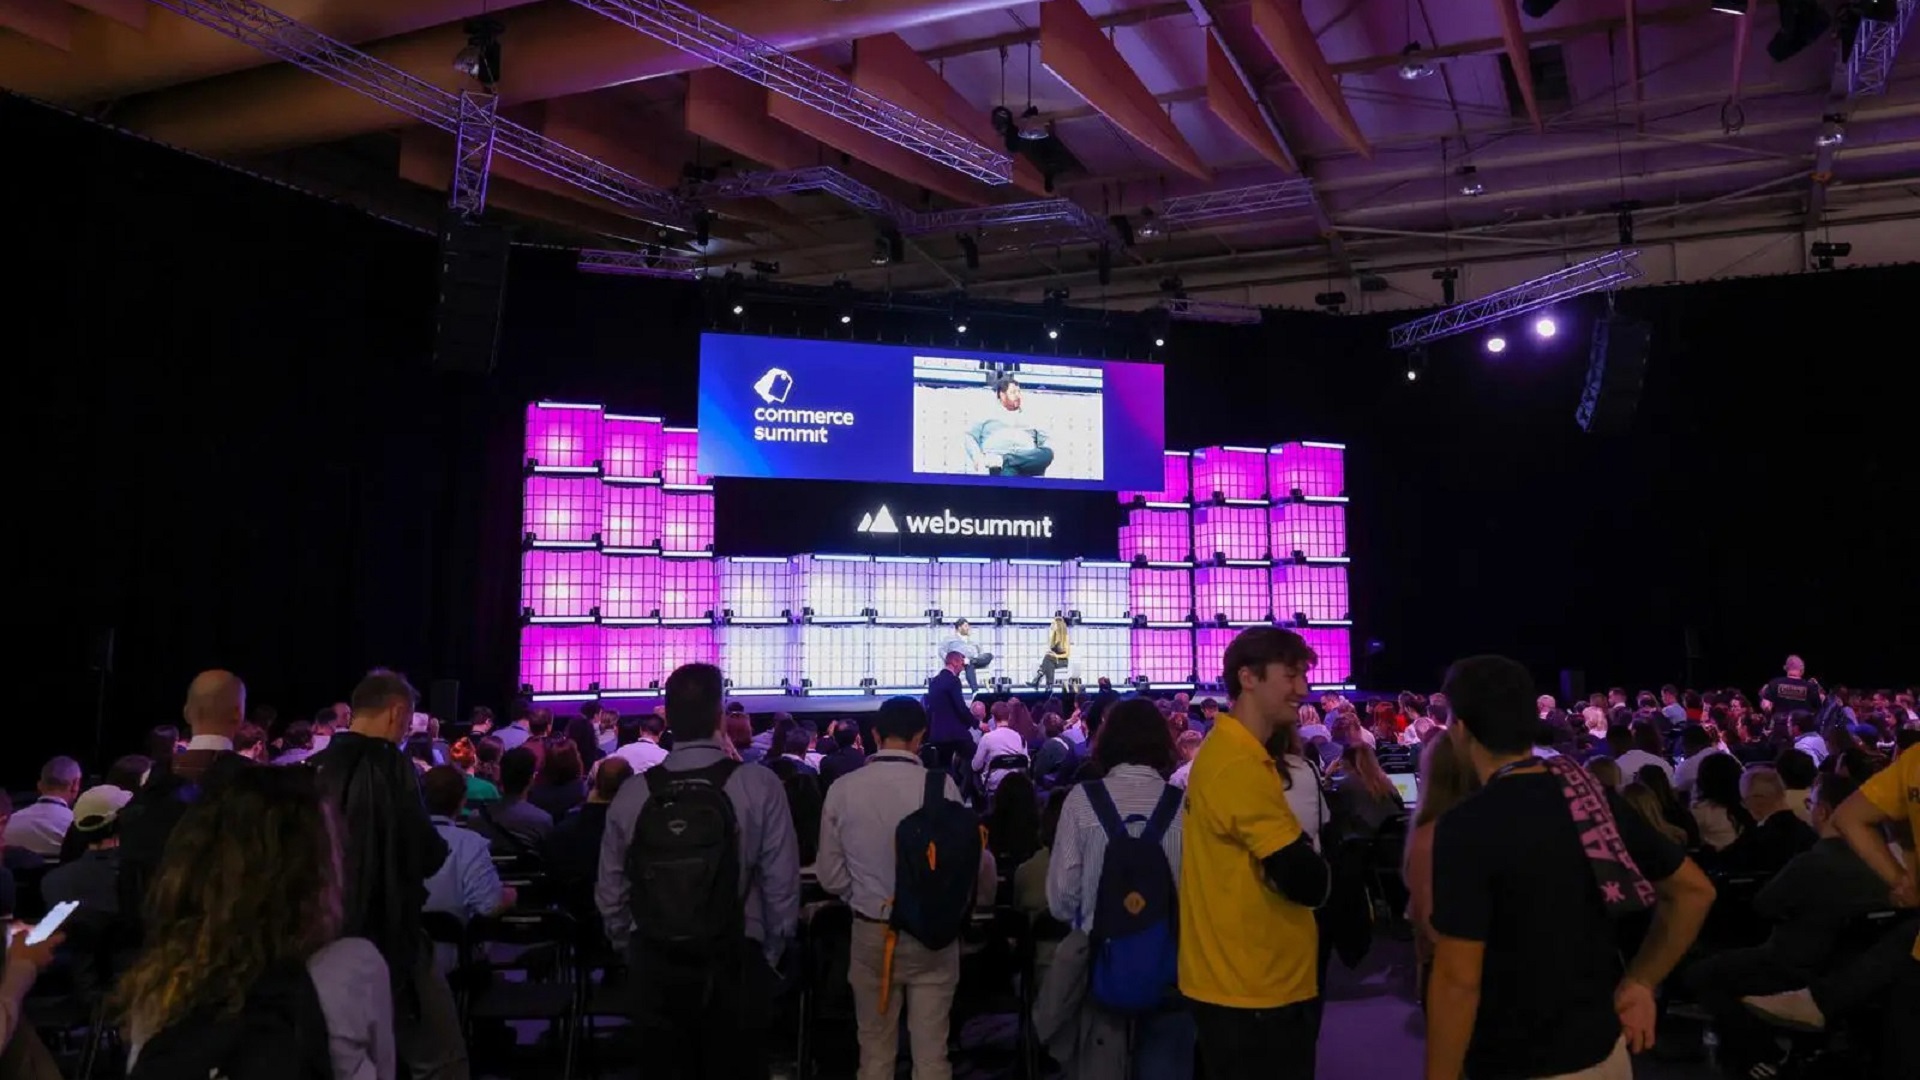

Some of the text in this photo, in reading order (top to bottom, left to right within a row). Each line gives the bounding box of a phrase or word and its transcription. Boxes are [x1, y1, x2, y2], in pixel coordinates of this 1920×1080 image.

[754, 407, 854, 426] commerce
[754, 426, 828, 443] summit
[906, 508, 1053, 537] websummit
